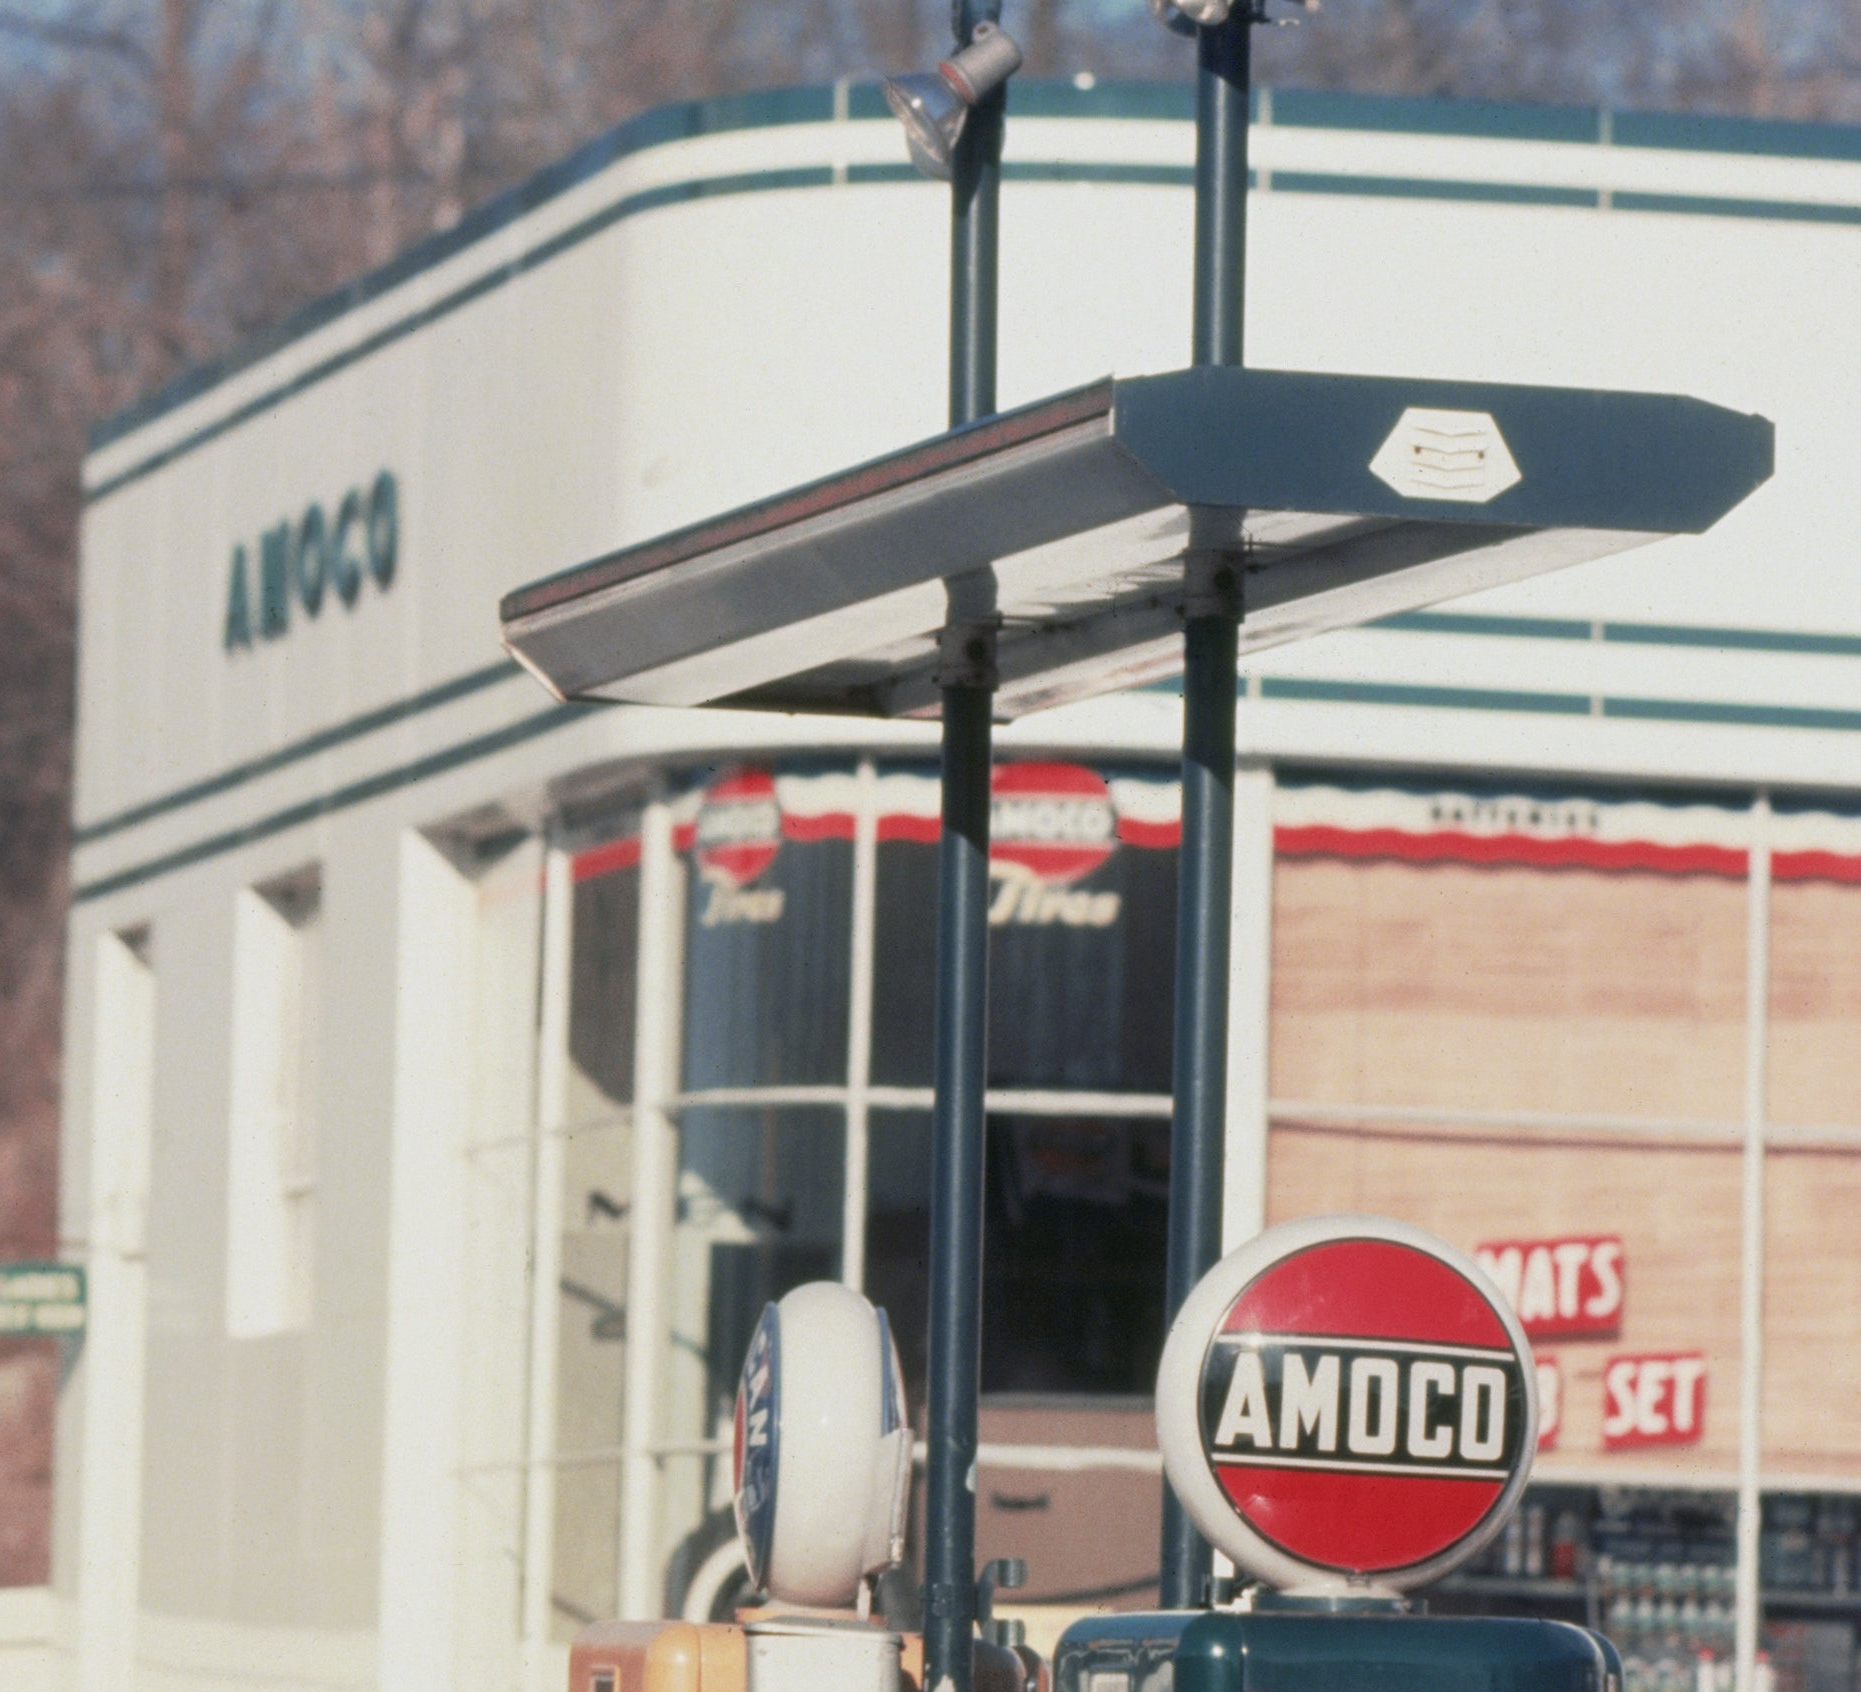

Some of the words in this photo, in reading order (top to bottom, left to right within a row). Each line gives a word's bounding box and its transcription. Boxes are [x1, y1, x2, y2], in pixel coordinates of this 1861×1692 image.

[224, 466, 398, 655] AMOCO
[1215, 1351, 1508, 1462] AMOCO
[1604, 1358, 1706, 1437] SET
